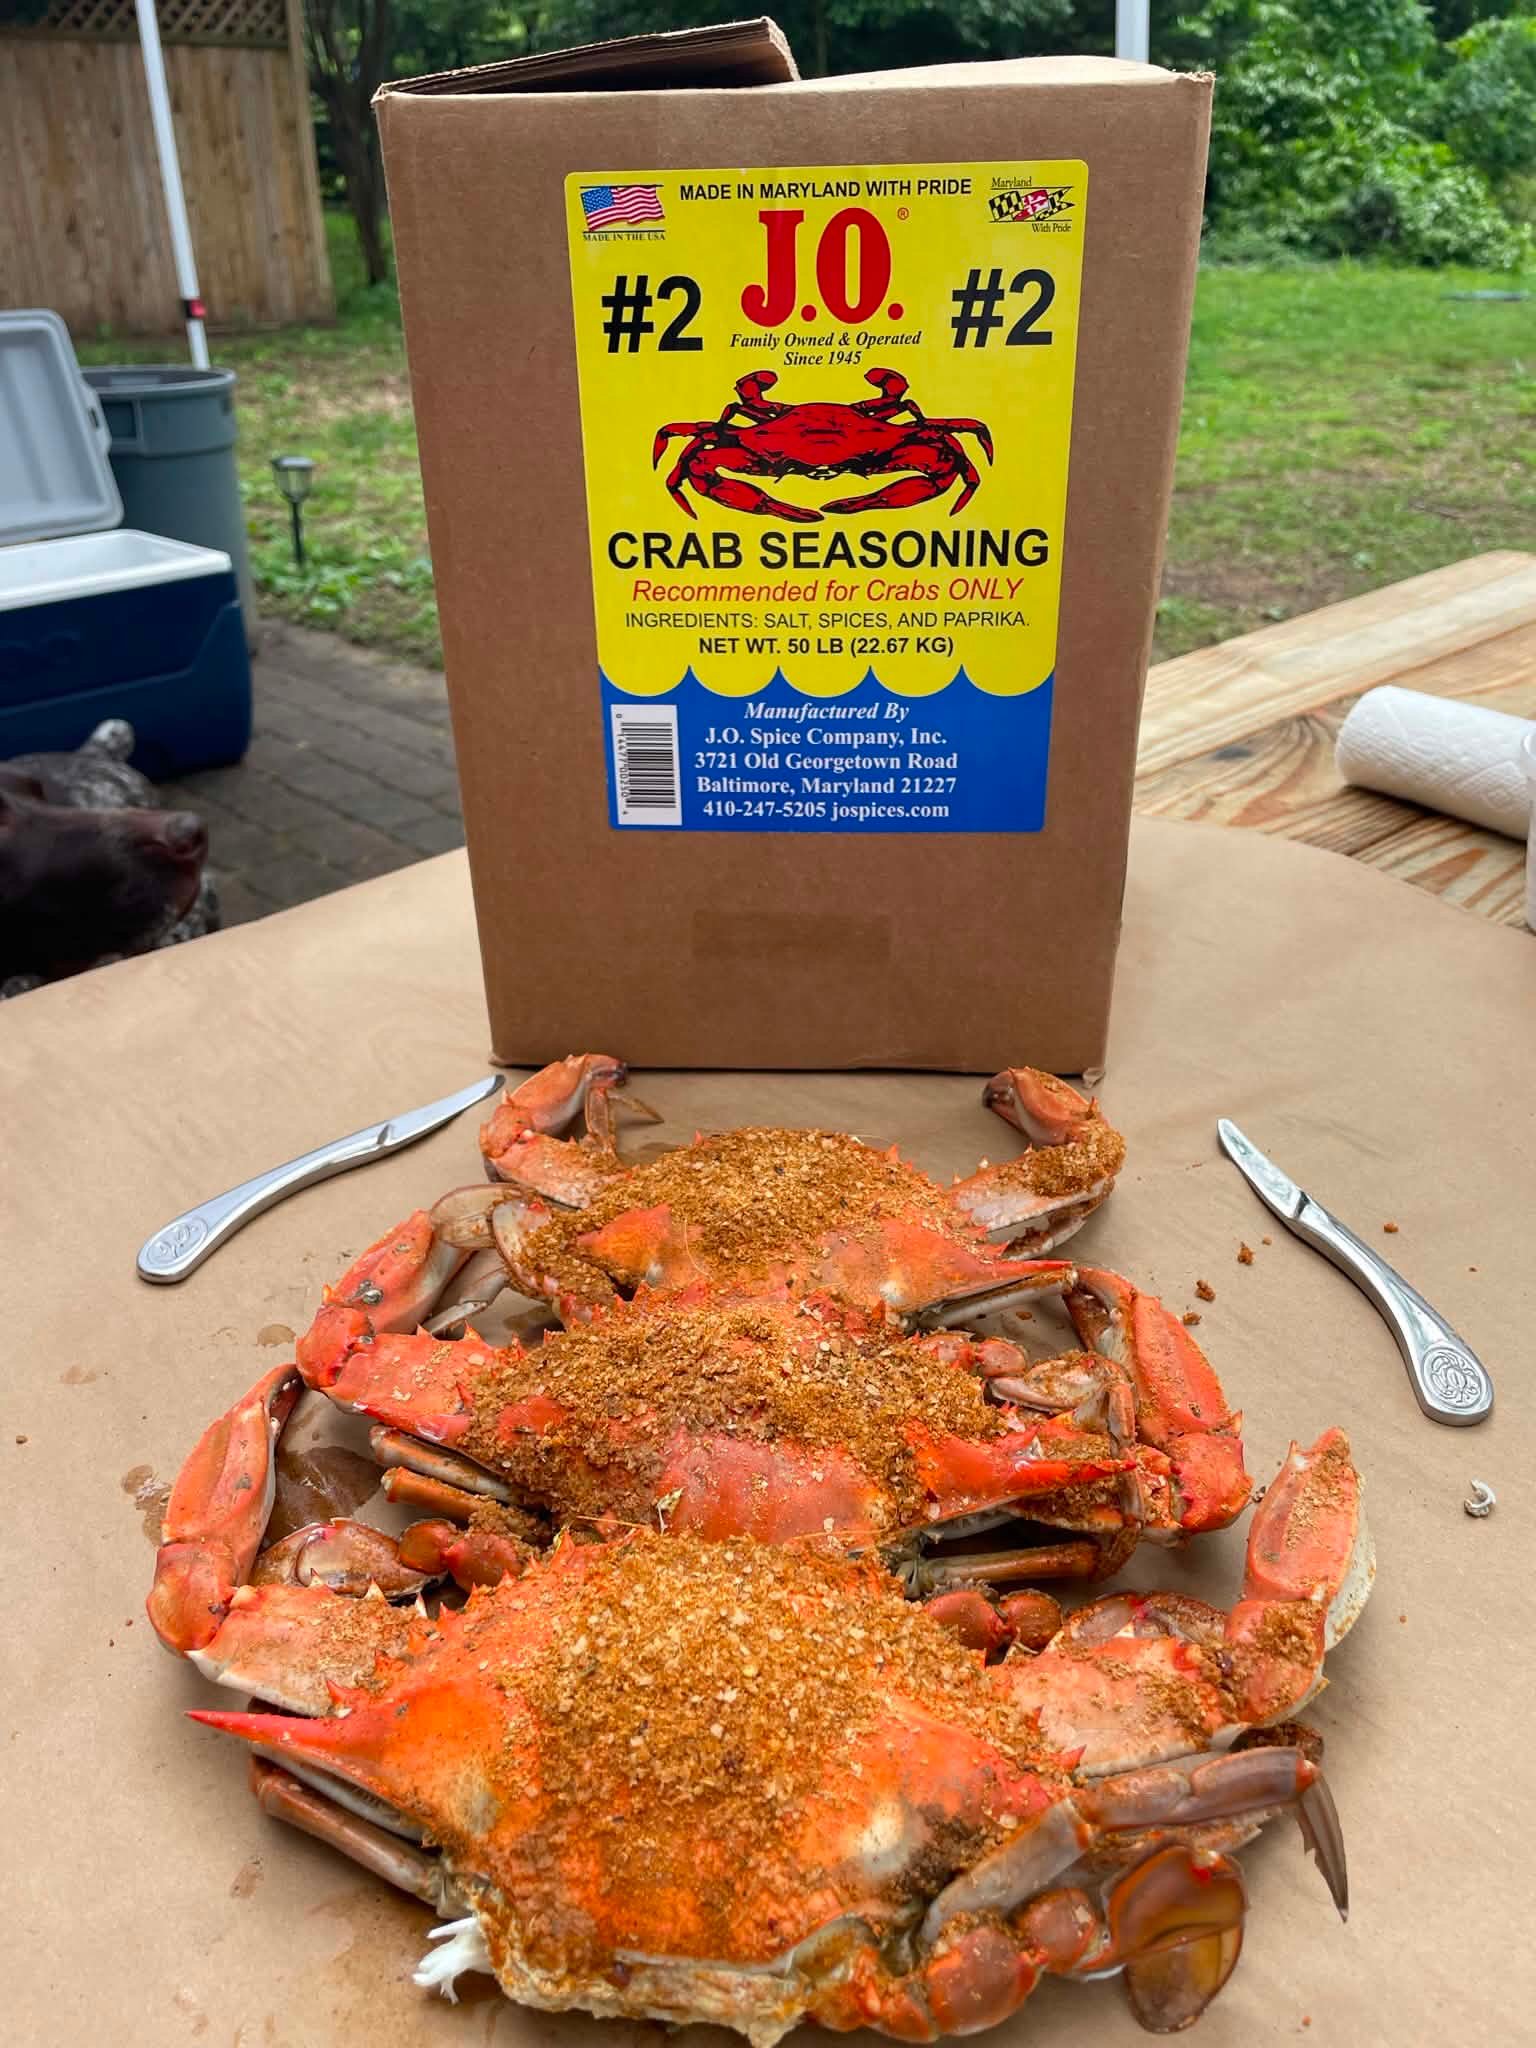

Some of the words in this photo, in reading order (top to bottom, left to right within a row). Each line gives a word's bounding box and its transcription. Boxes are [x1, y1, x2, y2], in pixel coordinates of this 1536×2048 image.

[680, 184, 732, 200] MADE
[737, 183, 754, 199] IN
[760, 181, 861, 199] MARYLAND
[865, 180, 912, 197] WITH
[917, 178, 972, 196] PRIDE
[991, 176, 1032, 188] Maryland
[583, 233, 609, 242] MADE
[613, 233, 622, 242] IN
[624, 233, 645, 241] THE
[647, 232, 666, 241] USA
[1032, 223, 1051, 233] With
[1052, 223, 1072, 233] Pride
[741, 207, 904, 328] J.O.
[601, 275, 704, 354] #2
[951, 268, 1056, 349] #2
[730, 333, 781, 351] Family
[784, 332, 835, 347] Owned
[838, 332, 851, 347] &
[856, 331, 922, 350] Operated
[783, 351, 824, 366] Since
[828, 350, 862, 365] 1945
[608, 531, 743, 570] CRAB
[759, 528, 1049, 570] SEASONING
[632, 579, 818, 602] Recommended
[825, 579, 860, 602] for
[866, 578, 940, 602] Crabs
[948, 577, 1025, 601] ONLY
[625, 612, 759, 629] INGREDIENTS:
[764, 612, 813, 631] SALT,
[818, 612, 892, 631] SPICES,
[897, 612, 938, 628] AND
[943, 611, 1031, 628] PAPRIKA.
[699, 638, 740, 655] NET
[745, 638, 781, 655] WT.
[788, 638, 810, 655] 50
[817, 638, 844, 654] LB
[850, 637, 909, 658] (22.67
[915, 636, 955, 657] KG)
[744, 702, 879, 721] Manufactured
[884, 702, 910, 724] By
[705, 727, 745, 745] J.O.
[750, 727, 802, 749] Spice
[806, 727, 904, 749] Company,
[911, 727, 947, 745] Inc.
[695, 752, 737, 769] 3721
[744, 752, 780, 769] Old
[785, 753, 902, 775] Georgetown
[908, 752, 958, 769] Road
[697, 776, 796, 797] Baltimore,
[802, 777, 896, 799] Maryland
[901, 777, 957, 794] 21227
[703, 801, 827, 818] 410-247-5205
[831, 801, 950, 823] jospices.com
